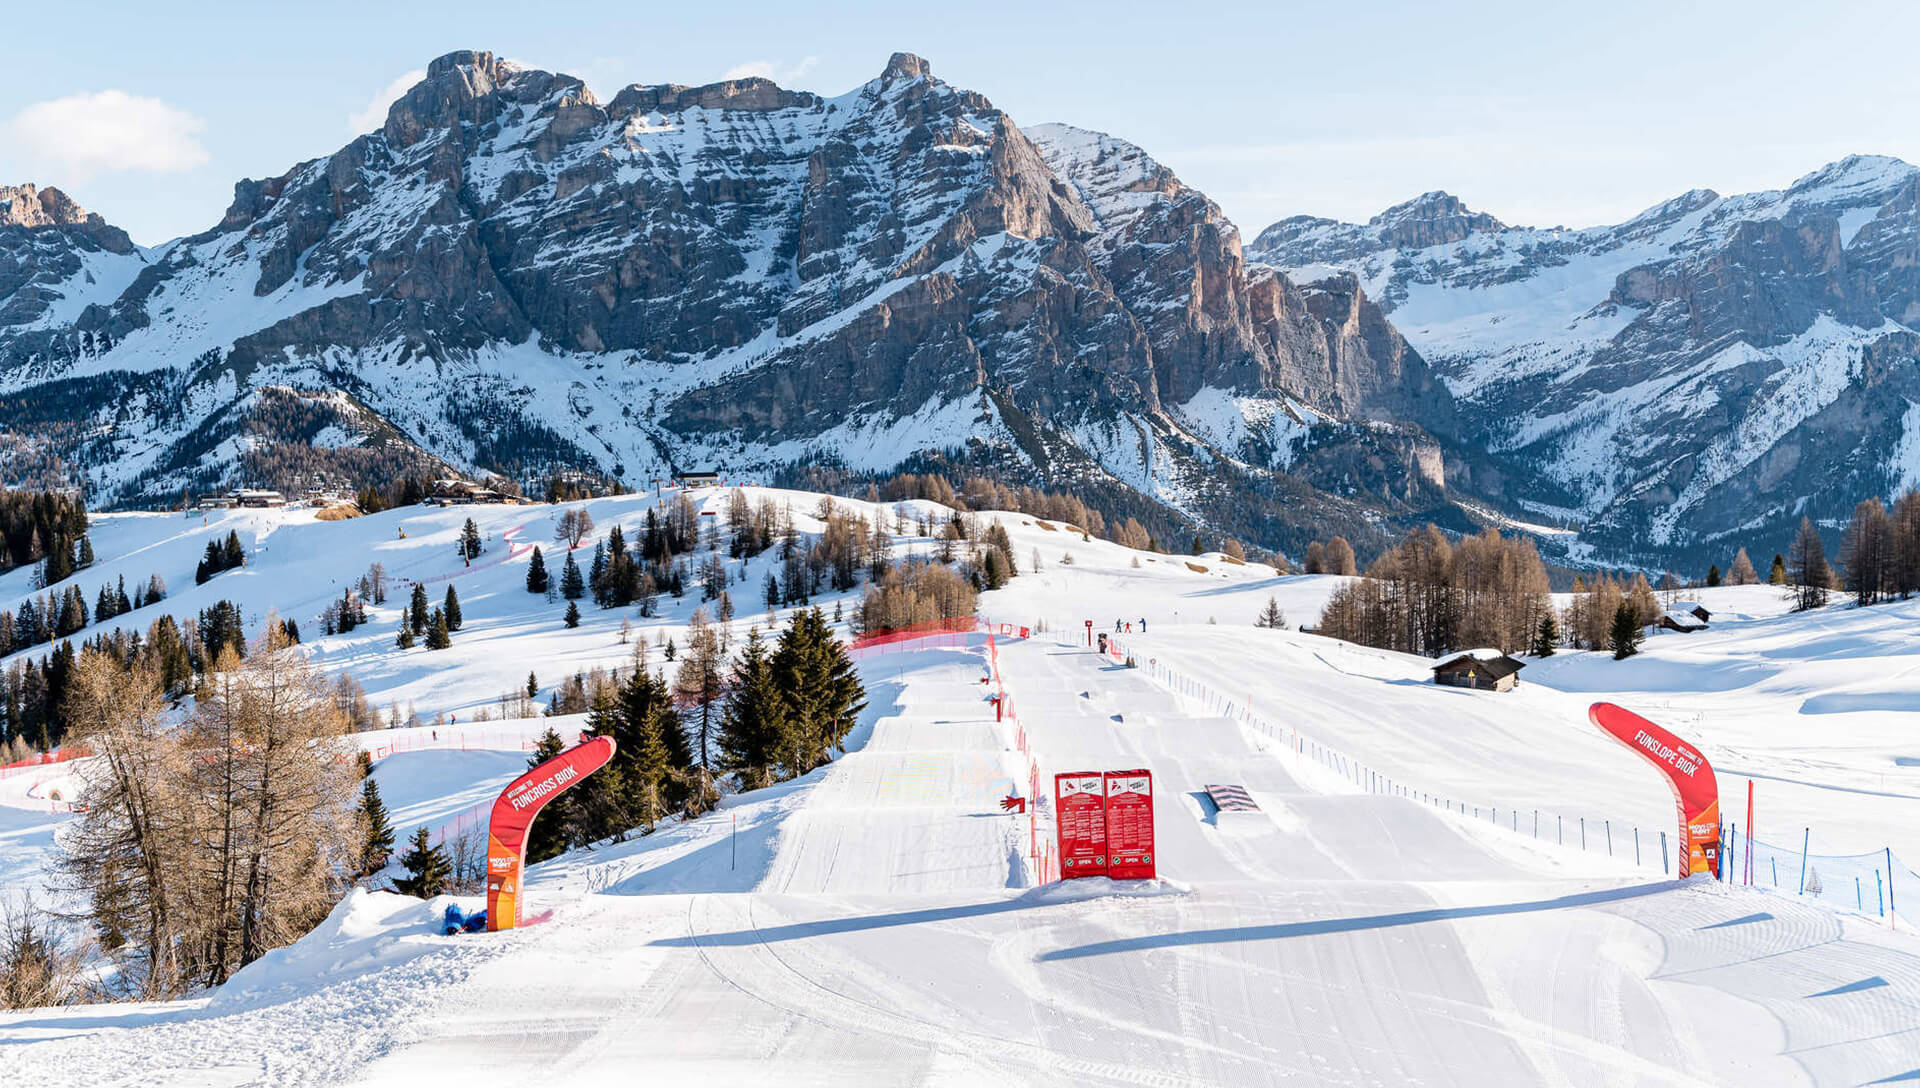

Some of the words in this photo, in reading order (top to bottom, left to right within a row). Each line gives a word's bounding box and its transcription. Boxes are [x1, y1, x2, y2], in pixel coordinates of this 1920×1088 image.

[1634, 729, 1678, 764] FUNSLOPE
[1675, 757, 1699, 777] BIOK
[1677, 745, 1697, 761] WELCOME
[1696, 757, 1703, 765] TO
[507, 783, 528, 798] WELCOME
[512, 777, 558, 811] FUNCROSS
